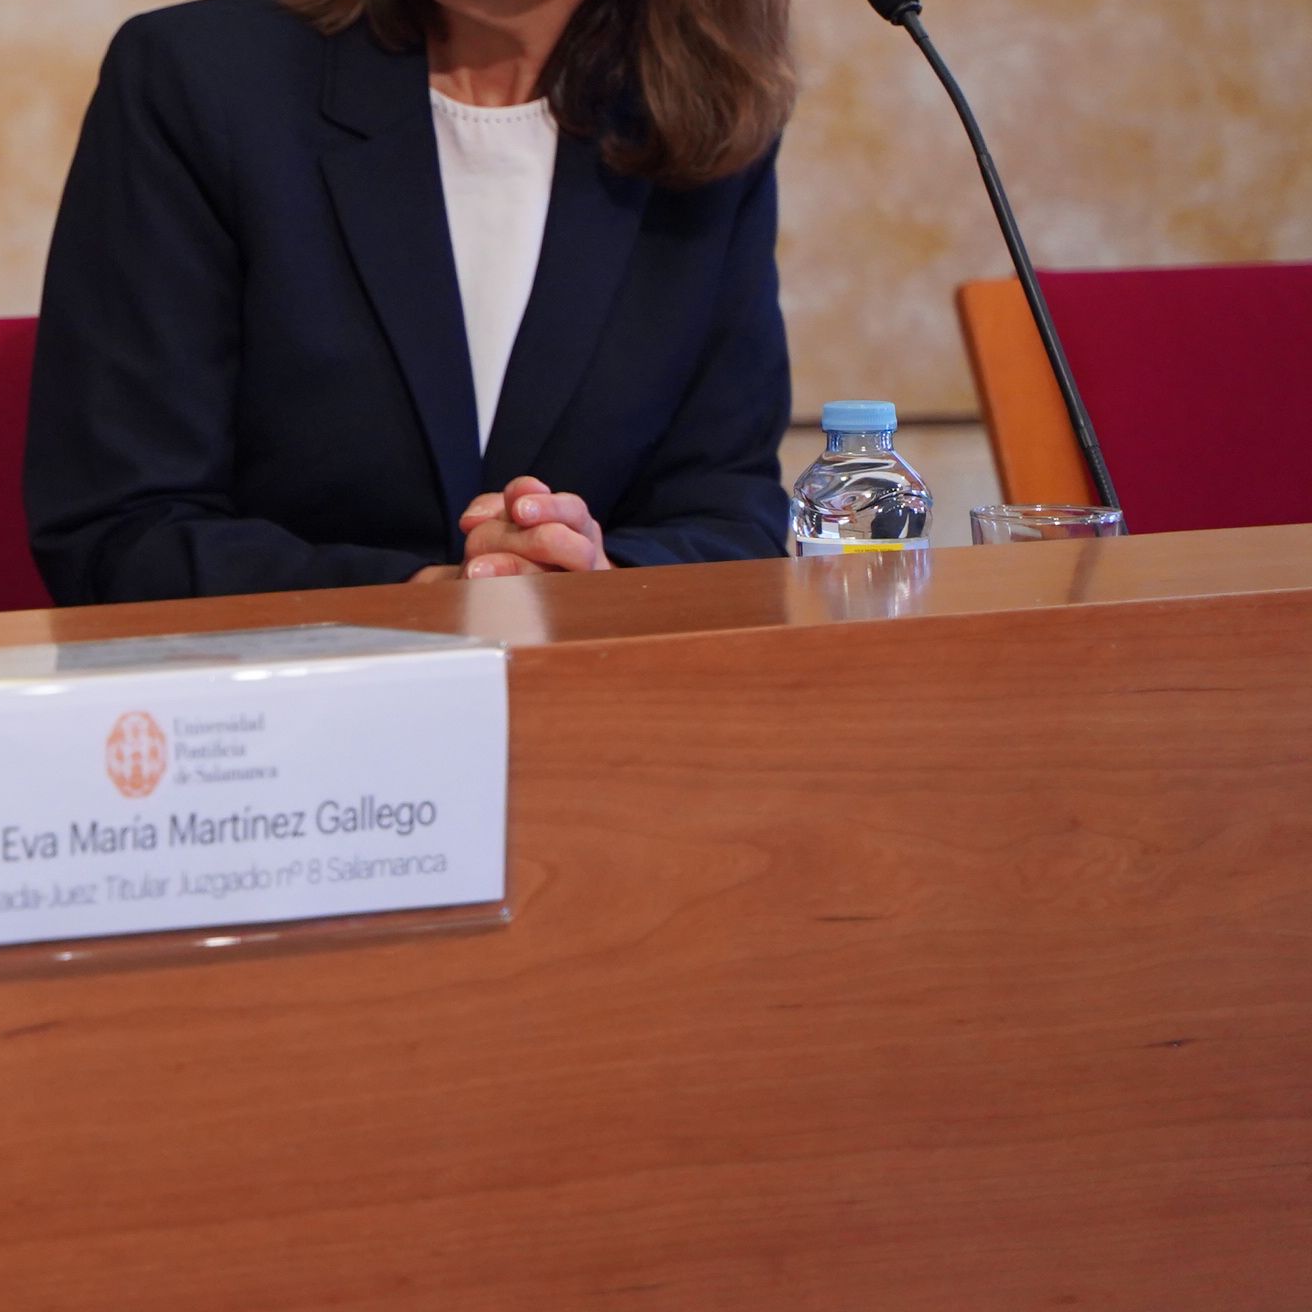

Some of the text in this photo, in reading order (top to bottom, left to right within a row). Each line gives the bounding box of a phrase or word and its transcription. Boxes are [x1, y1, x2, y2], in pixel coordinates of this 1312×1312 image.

[1, 825, 59, 863] Eva
[69, 815, 158, 857] María
[169, 805, 307, 848] Martínez
[315, 793, 437, 837] Gallego
[327, 851, 449, 884] Salamanca
